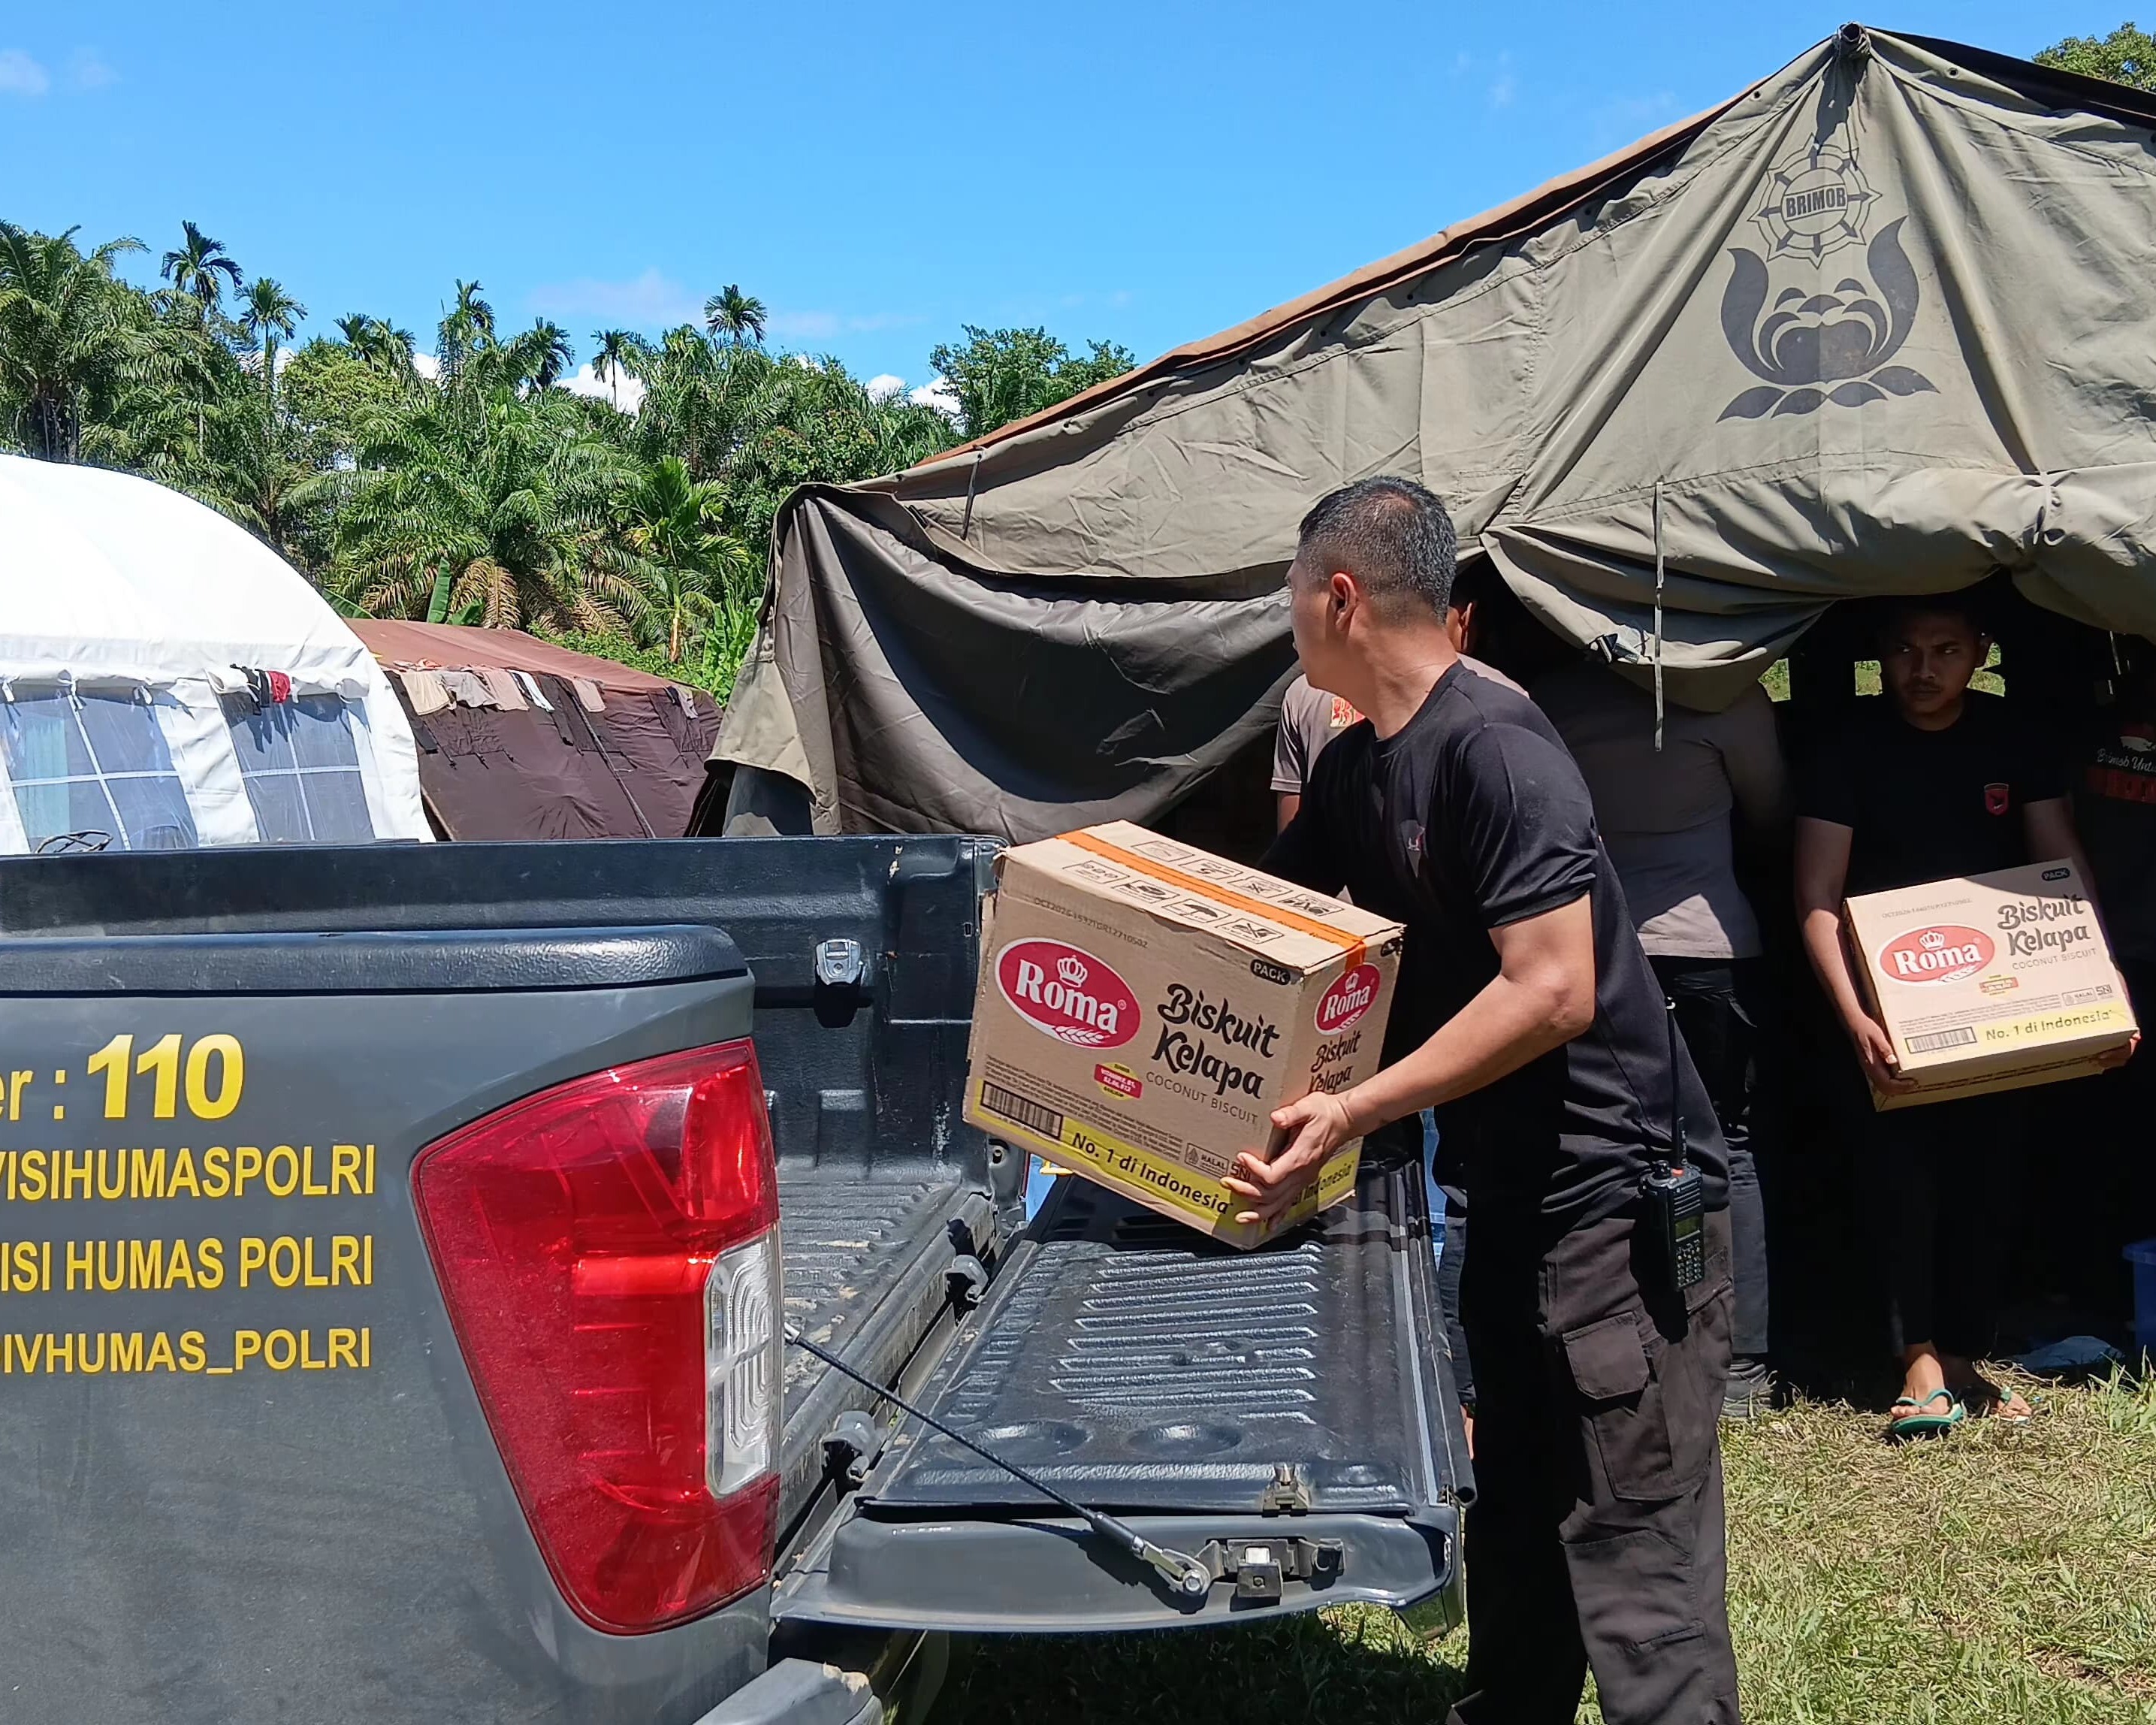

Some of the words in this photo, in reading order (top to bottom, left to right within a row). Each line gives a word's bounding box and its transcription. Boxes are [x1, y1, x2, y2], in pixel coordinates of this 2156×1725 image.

[1786, 186, 1847, 218] BRIMOB
[2043, 869, 2067, 879] PACK
[1997, 894, 2085, 930] Biskuit
[1892, 944, 1983, 975] Roma
[2007, 926, 2092, 956] Kelapa
[2012, 955, 2058, 970] COCONUT
[2061, 947, 2097, 961] BISCUIT
[1015, 949, 1118, 1035] Roma
[1252, 962, 1288, 983] PACK
[1157, 983, 1281, 1059] Biskuit
[1323, 985, 1371, 1023] Roma
[1985, 1028, 2010, 1041] No.
[2013, 1025, 2019, 1036] 1
[2025, 1020, 2038, 1034] di
[1151, 1022, 1265, 1100] Kelapa
[1310, 1030, 1362, 1074] Biskuit
[0, 1070, 34, 1120] r
[87, 1034, 244, 1119] 110
[1146, 1071, 1208, 1104] COCONUT
[1210, 1097, 1258, 1125] BISCUIT
[0, 1144, 375, 1201] ISIHUMASPOLRI
[1072, 1132, 1100, 1158] No.
[1106, 1149, 1115, 1164] 1
[1119, 1156, 1137, 1174] di
[66, 1237, 225, 1291] HUMAS
[240, 1234, 373, 1288] POLRI
